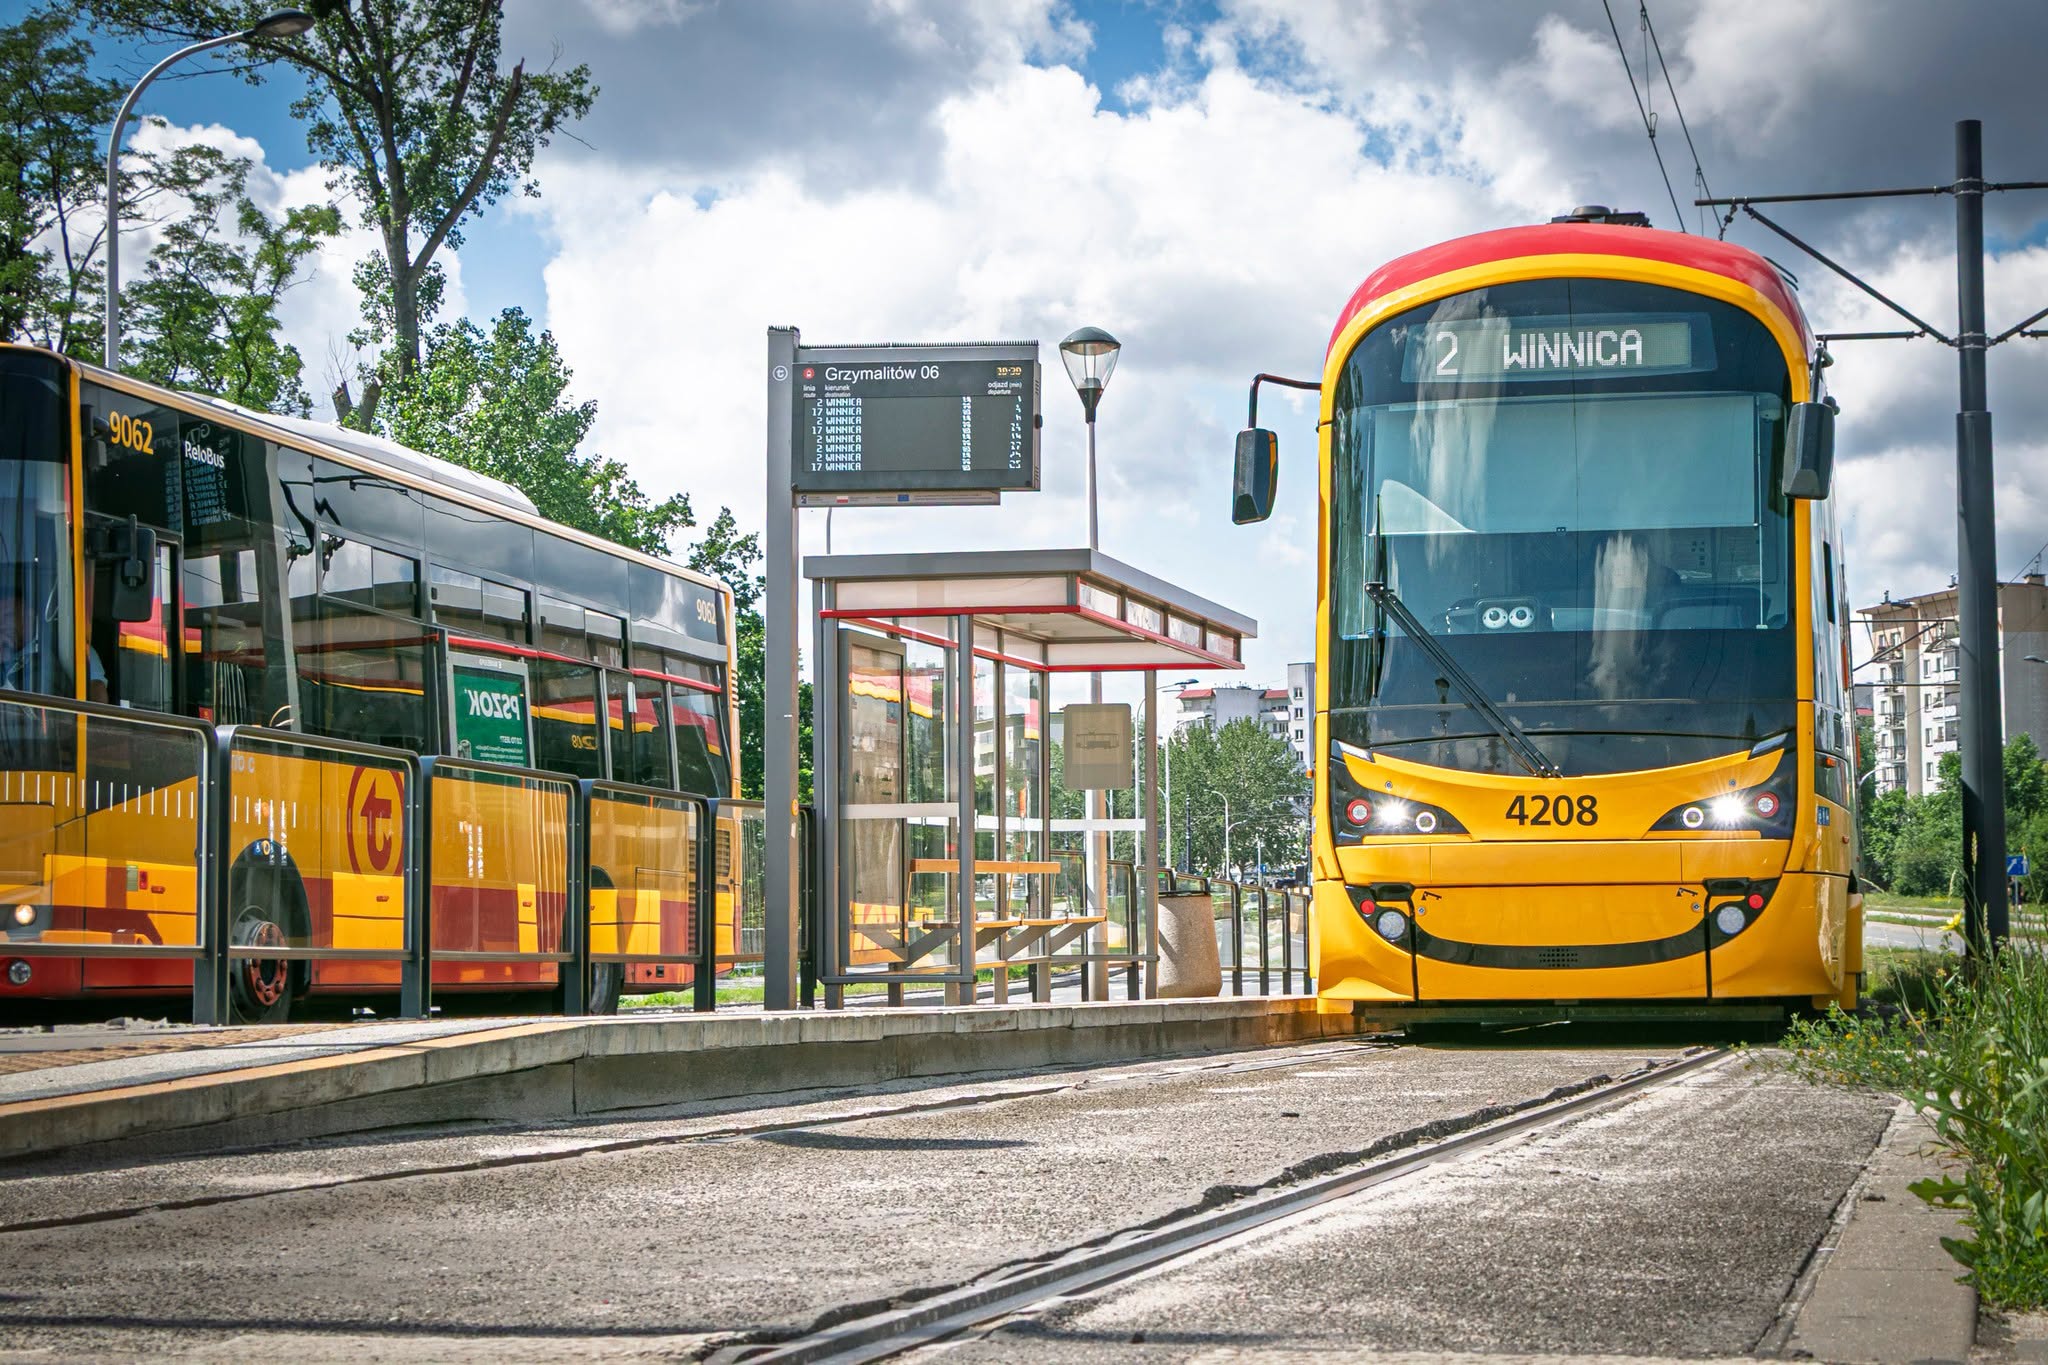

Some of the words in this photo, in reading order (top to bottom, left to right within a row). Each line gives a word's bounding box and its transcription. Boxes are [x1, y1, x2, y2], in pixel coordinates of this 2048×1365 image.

[1436, 331, 1459, 376] 2
[1503, 329, 1643, 370] WINNICA
[825, 365, 917, 384] Grzymalitów
[920, 365, 940, 380] 06
[987, 381, 1008, 389] odjazd
[816, 398, 823, 407] 2
[825, 398, 862, 407] WINNICA
[811, 407, 823, 416] 17
[825, 407, 862, 416] WINNICA
[816, 416, 823, 425] 2
[825, 416, 862, 425] WINNICA
[110, 411, 154, 455] 9062
[811, 425, 823, 434] 17
[825, 425, 862, 434] WINNICA
[816, 435, 823, 444] 2
[825, 435, 862, 444] WINNICA
[816, 444, 823, 453] 2
[825, 444, 862, 453] WINNICA
[184, 440, 225, 468] ReloBus
[816, 453, 823, 462] 2
[825, 453, 862, 462] WINNICA
[811, 462, 823, 471] 17
[825, 462, 862, 471] WINNICA
[696, 598, 717, 625] 9062
[1505, 794, 1599, 827] 4208
